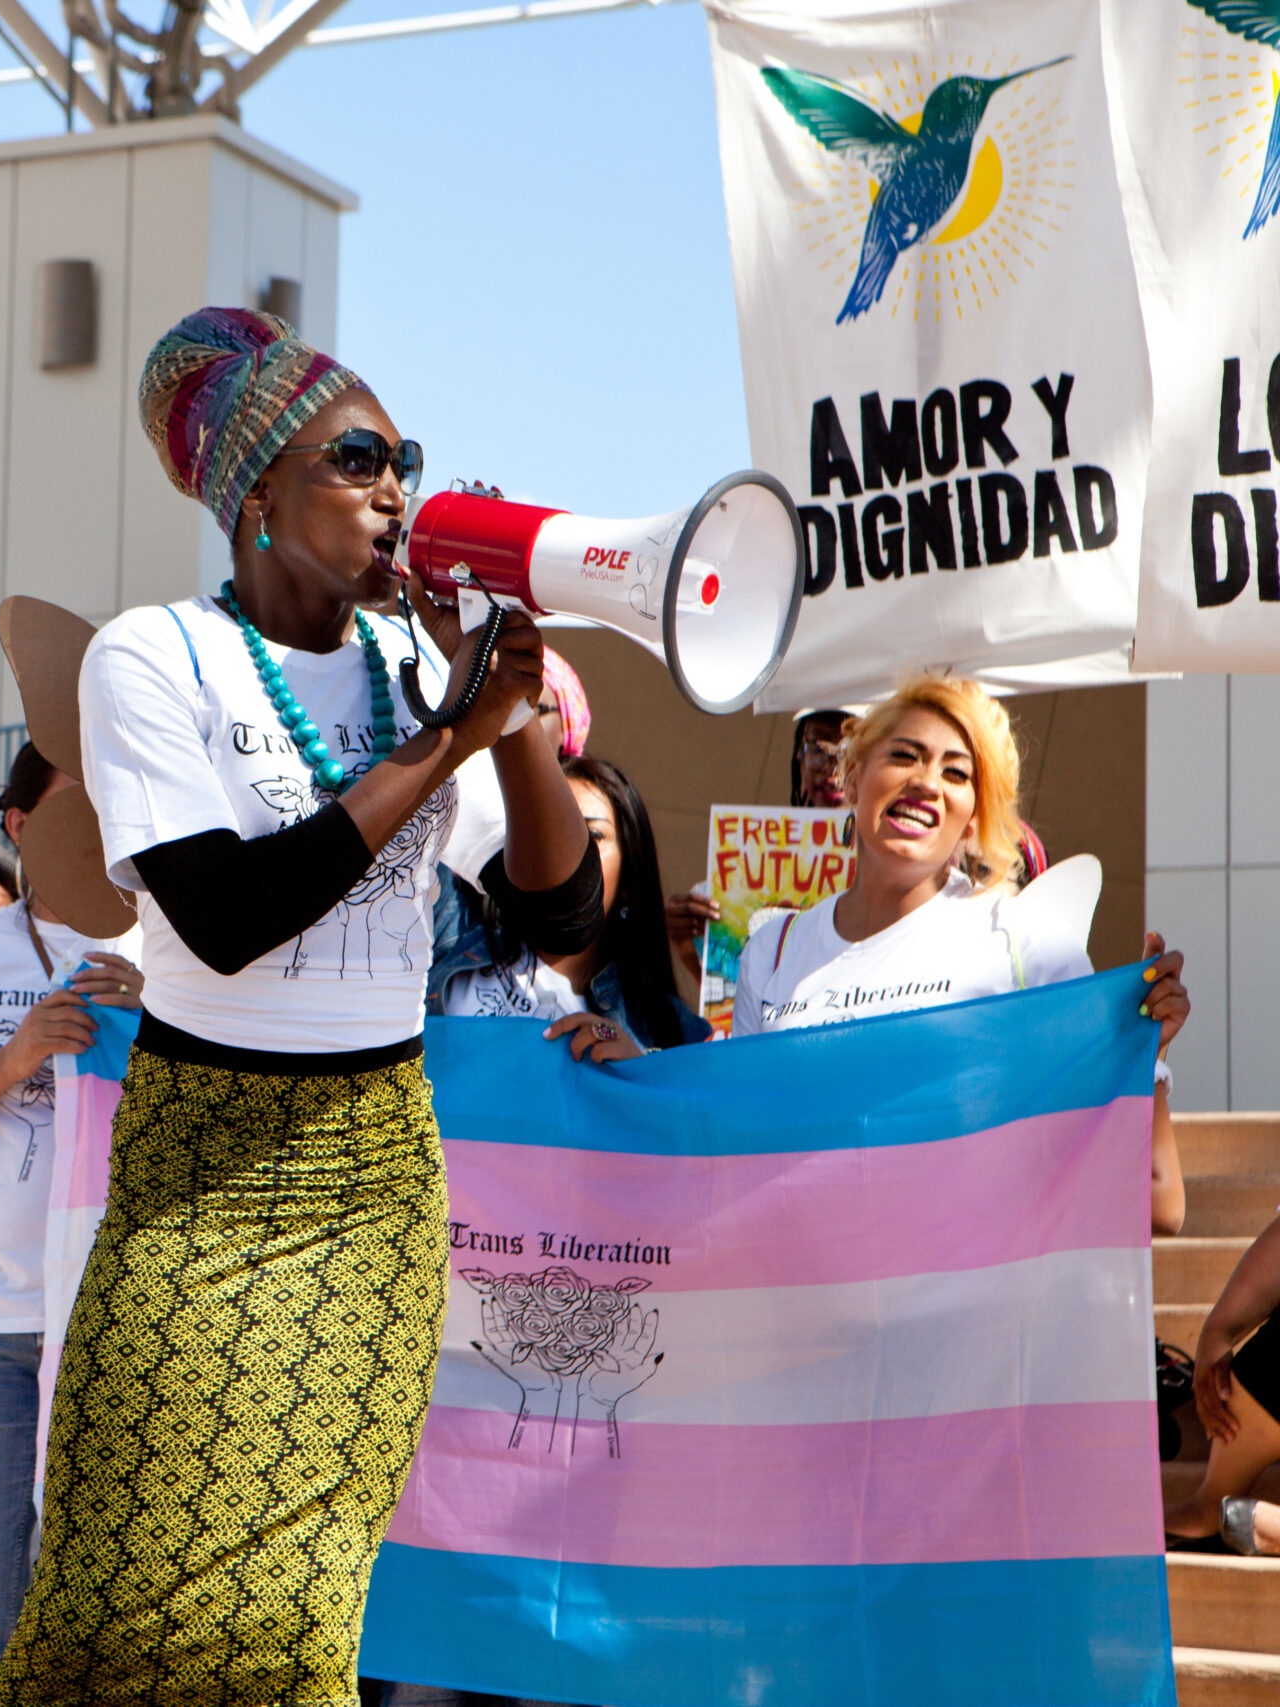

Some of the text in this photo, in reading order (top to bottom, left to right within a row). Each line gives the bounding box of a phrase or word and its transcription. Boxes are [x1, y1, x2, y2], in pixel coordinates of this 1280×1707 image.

[811, 372, 1075, 498] AMOR Y
[583, 546, 632, 571] PYLE
[796, 465, 1119, 597] DIGNIDAD
[449, 1222, 672, 1265] Trans Liberation
